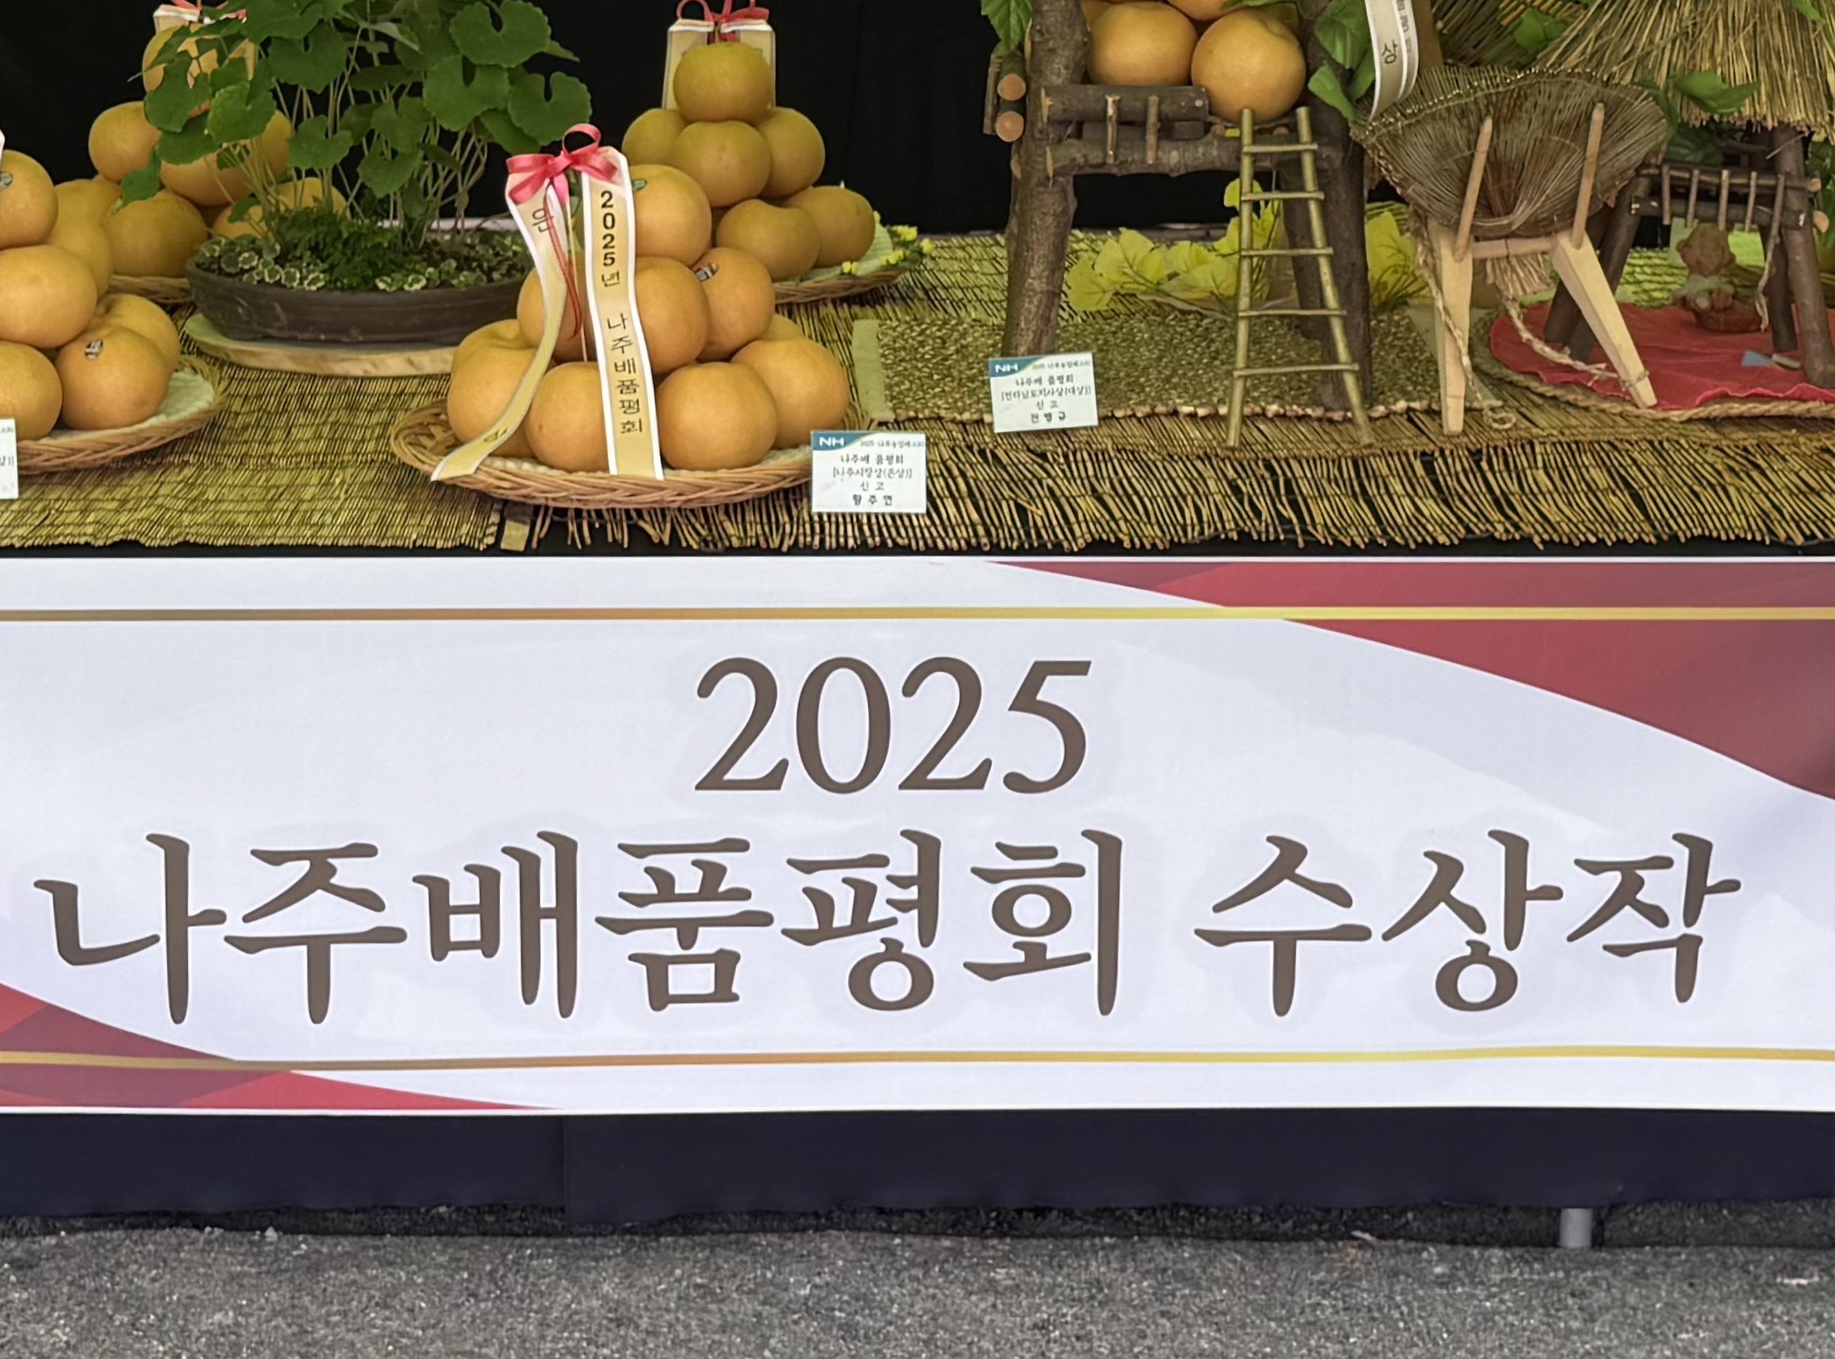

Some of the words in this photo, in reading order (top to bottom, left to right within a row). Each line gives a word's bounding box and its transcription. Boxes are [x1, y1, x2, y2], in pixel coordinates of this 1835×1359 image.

[1381, 40, 1399, 66] 상
[531, 207, 555, 234] 은
[600, 189, 622, 288] 2025년
[606, 312, 645, 436] 나주배품평회
[995, 363, 1019, 373] NH
[1015, 376, 1043, 386] 나주배
[819, 437, 845, 447] NH
[841, 454, 870, 464] 나주배
[694, 656, 1091, 794] 2025
[33, 828, 1122, 1025] 나주배품평회
[1194, 828, 1742, 1017] 수상작
